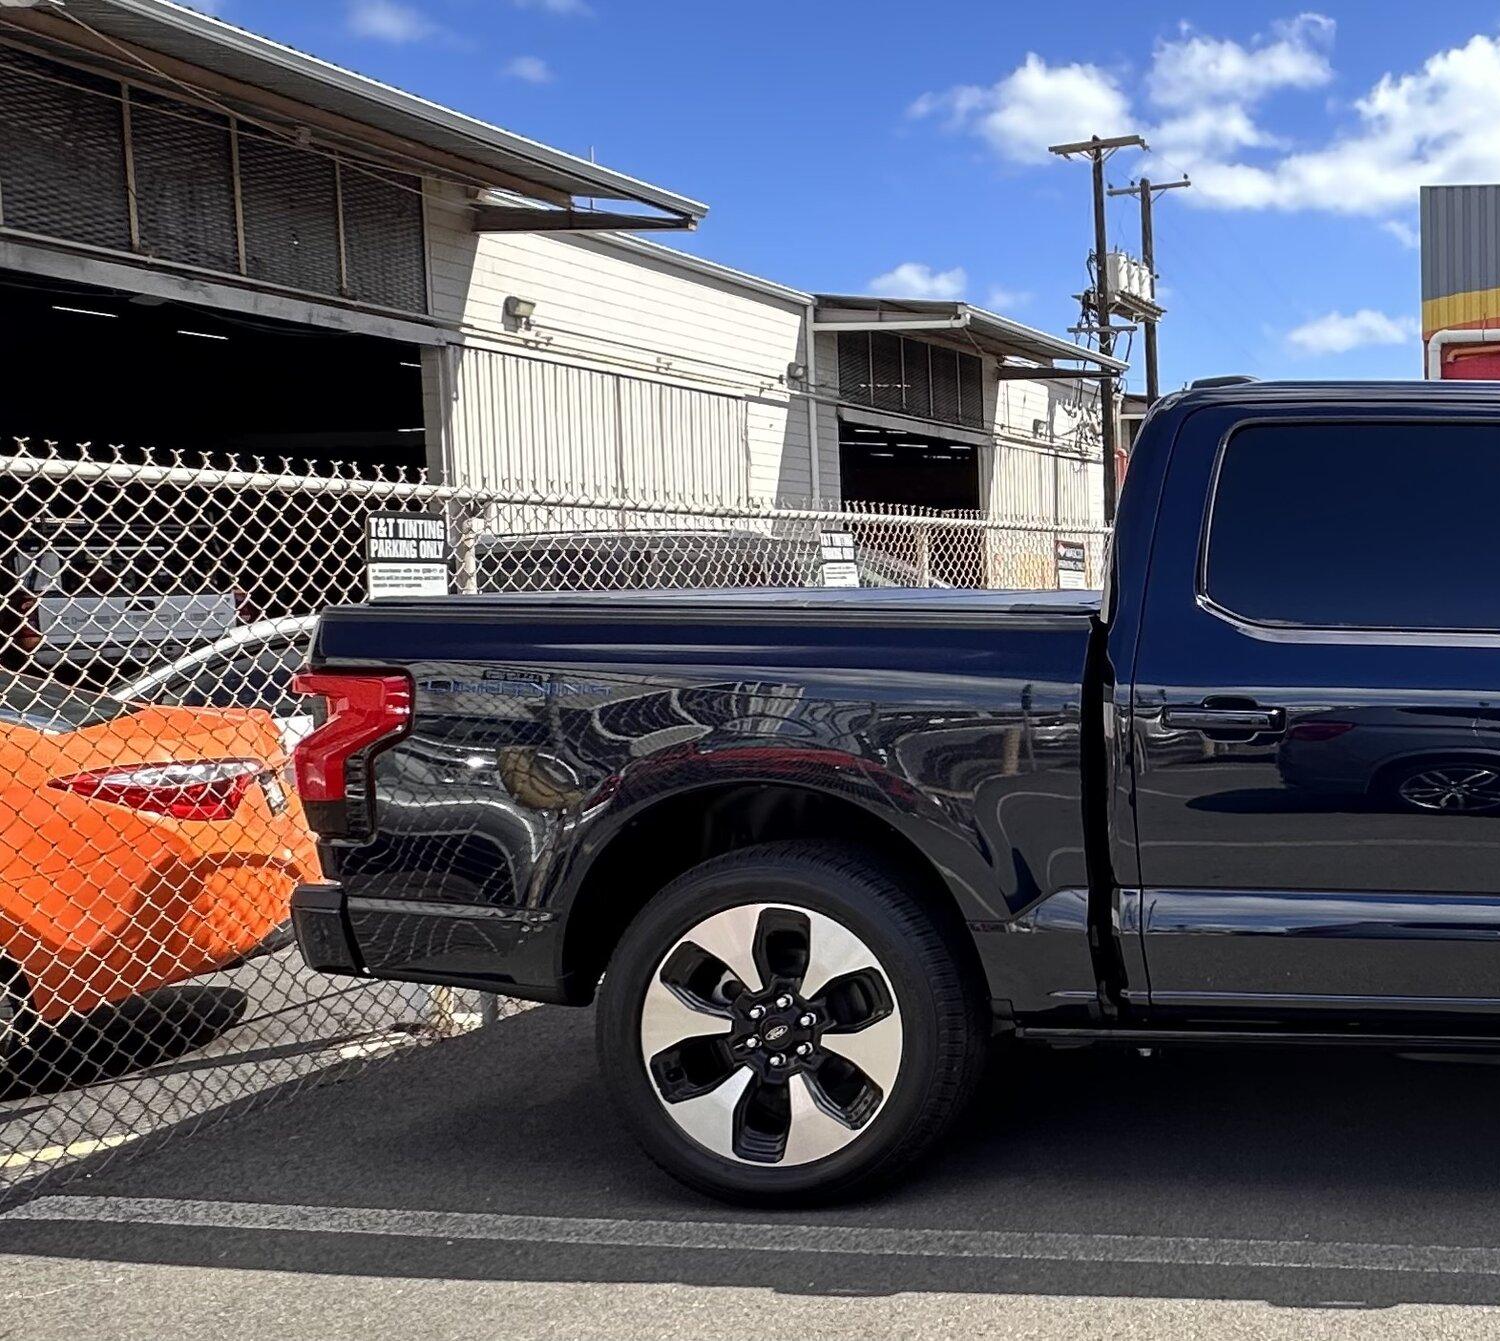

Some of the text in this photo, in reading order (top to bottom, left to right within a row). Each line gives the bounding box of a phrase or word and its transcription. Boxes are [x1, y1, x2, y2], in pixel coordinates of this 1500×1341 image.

[369, 517, 445, 540] T&T TINTING
[370, 539, 444, 559] PARKING ONLY
